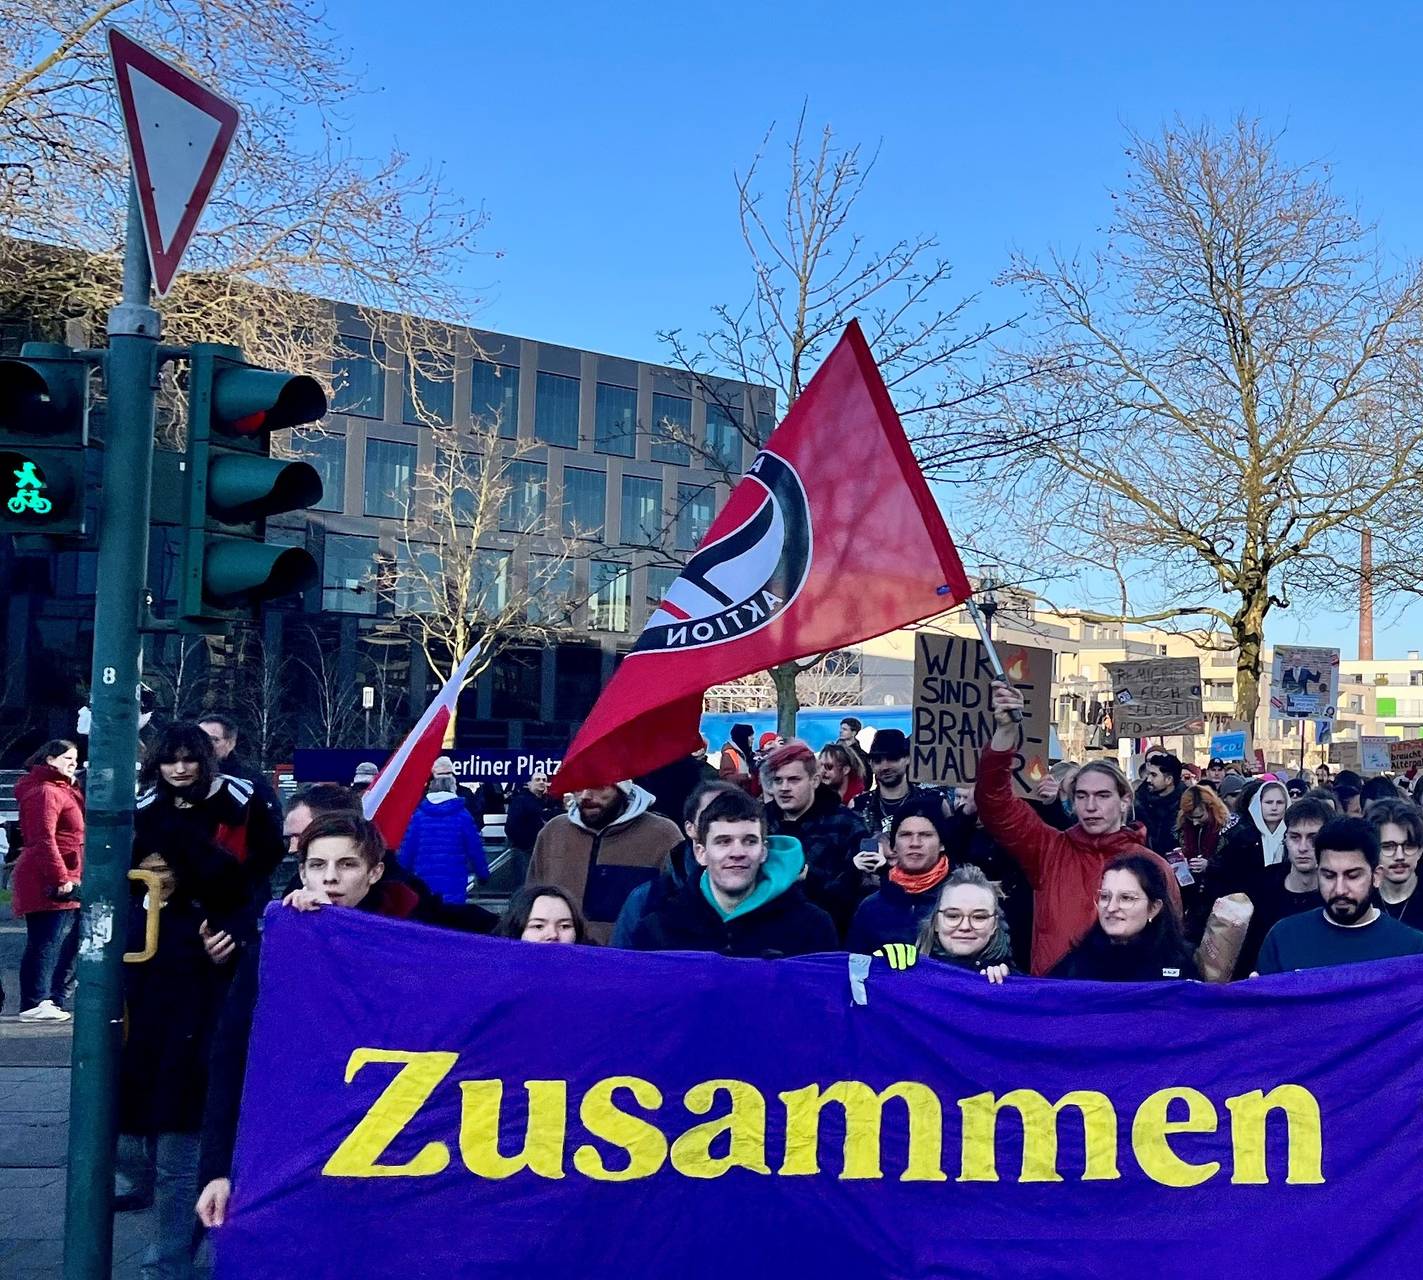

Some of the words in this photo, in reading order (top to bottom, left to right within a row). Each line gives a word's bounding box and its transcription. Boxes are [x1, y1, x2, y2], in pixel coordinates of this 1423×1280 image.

[103, 667, 116, 685] 8
[920, 635, 995, 680] WIR
[920, 677, 981, 708] SIND
[915, 707, 1042, 751] BRAN-
[452, 755, 512, 776] erliner
[518, 755, 562, 776] Platz
[913, 746, 1032, 793] MAUR
[322, 1047, 1326, 1187] Zusammen
